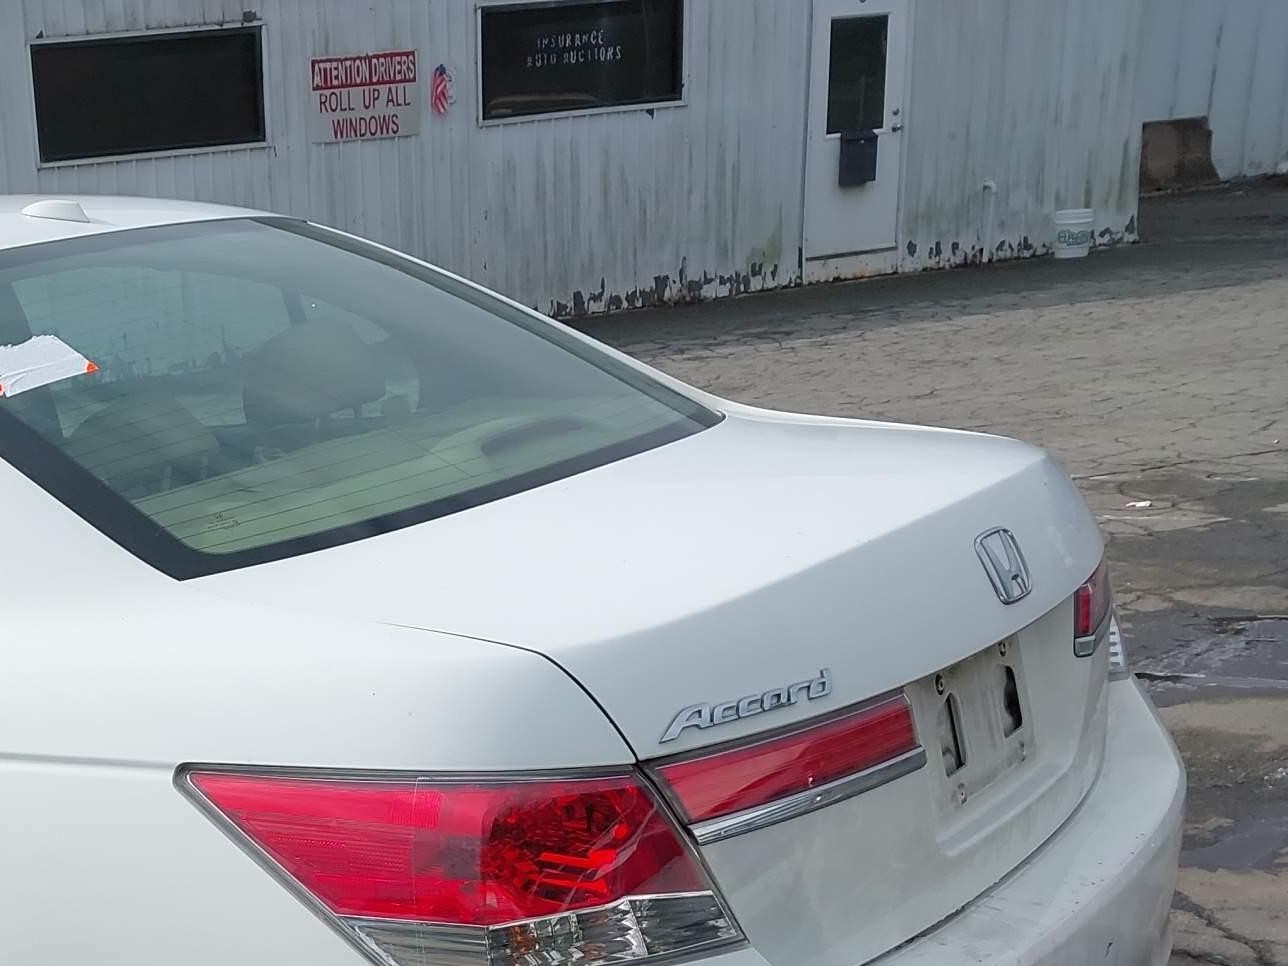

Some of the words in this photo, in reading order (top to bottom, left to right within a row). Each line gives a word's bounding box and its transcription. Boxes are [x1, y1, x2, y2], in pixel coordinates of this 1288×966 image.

[313, 60, 370, 89] ATTENTION
[372, 55, 415, 83] DRIVERS
[319, 89, 355, 113] ROLL
[362, 88, 380, 110] UP
[386, 86, 411, 107] ALL
[332, 114, 399, 139] WINDOWS
[659, 668, 832, 744] Accord
